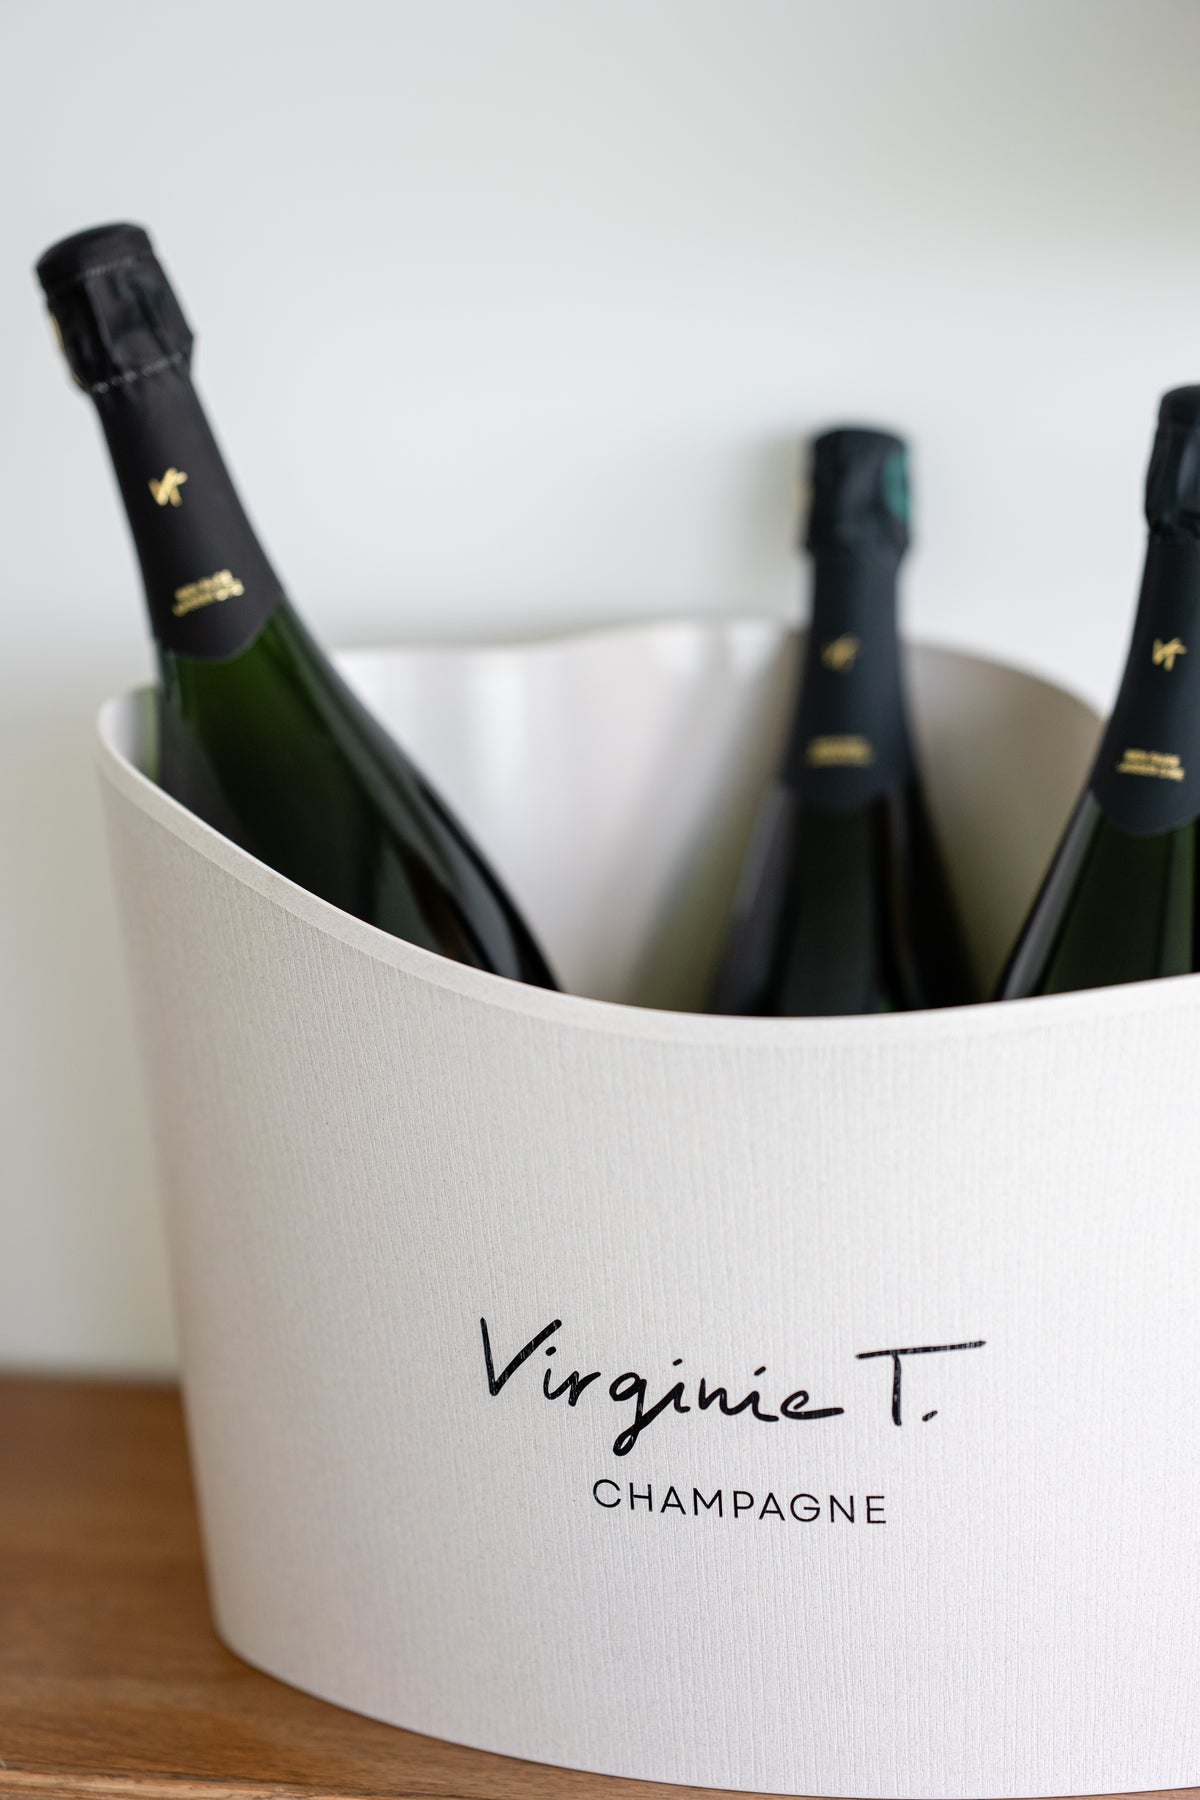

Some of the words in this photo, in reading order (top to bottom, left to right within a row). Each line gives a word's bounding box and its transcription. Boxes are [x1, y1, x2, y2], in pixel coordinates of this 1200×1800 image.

[480, 1317, 844, 1457] Virginie
[855, 1340, 986, 1426] T.
[592, 1478, 887, 1524] CHAMPAGNE
